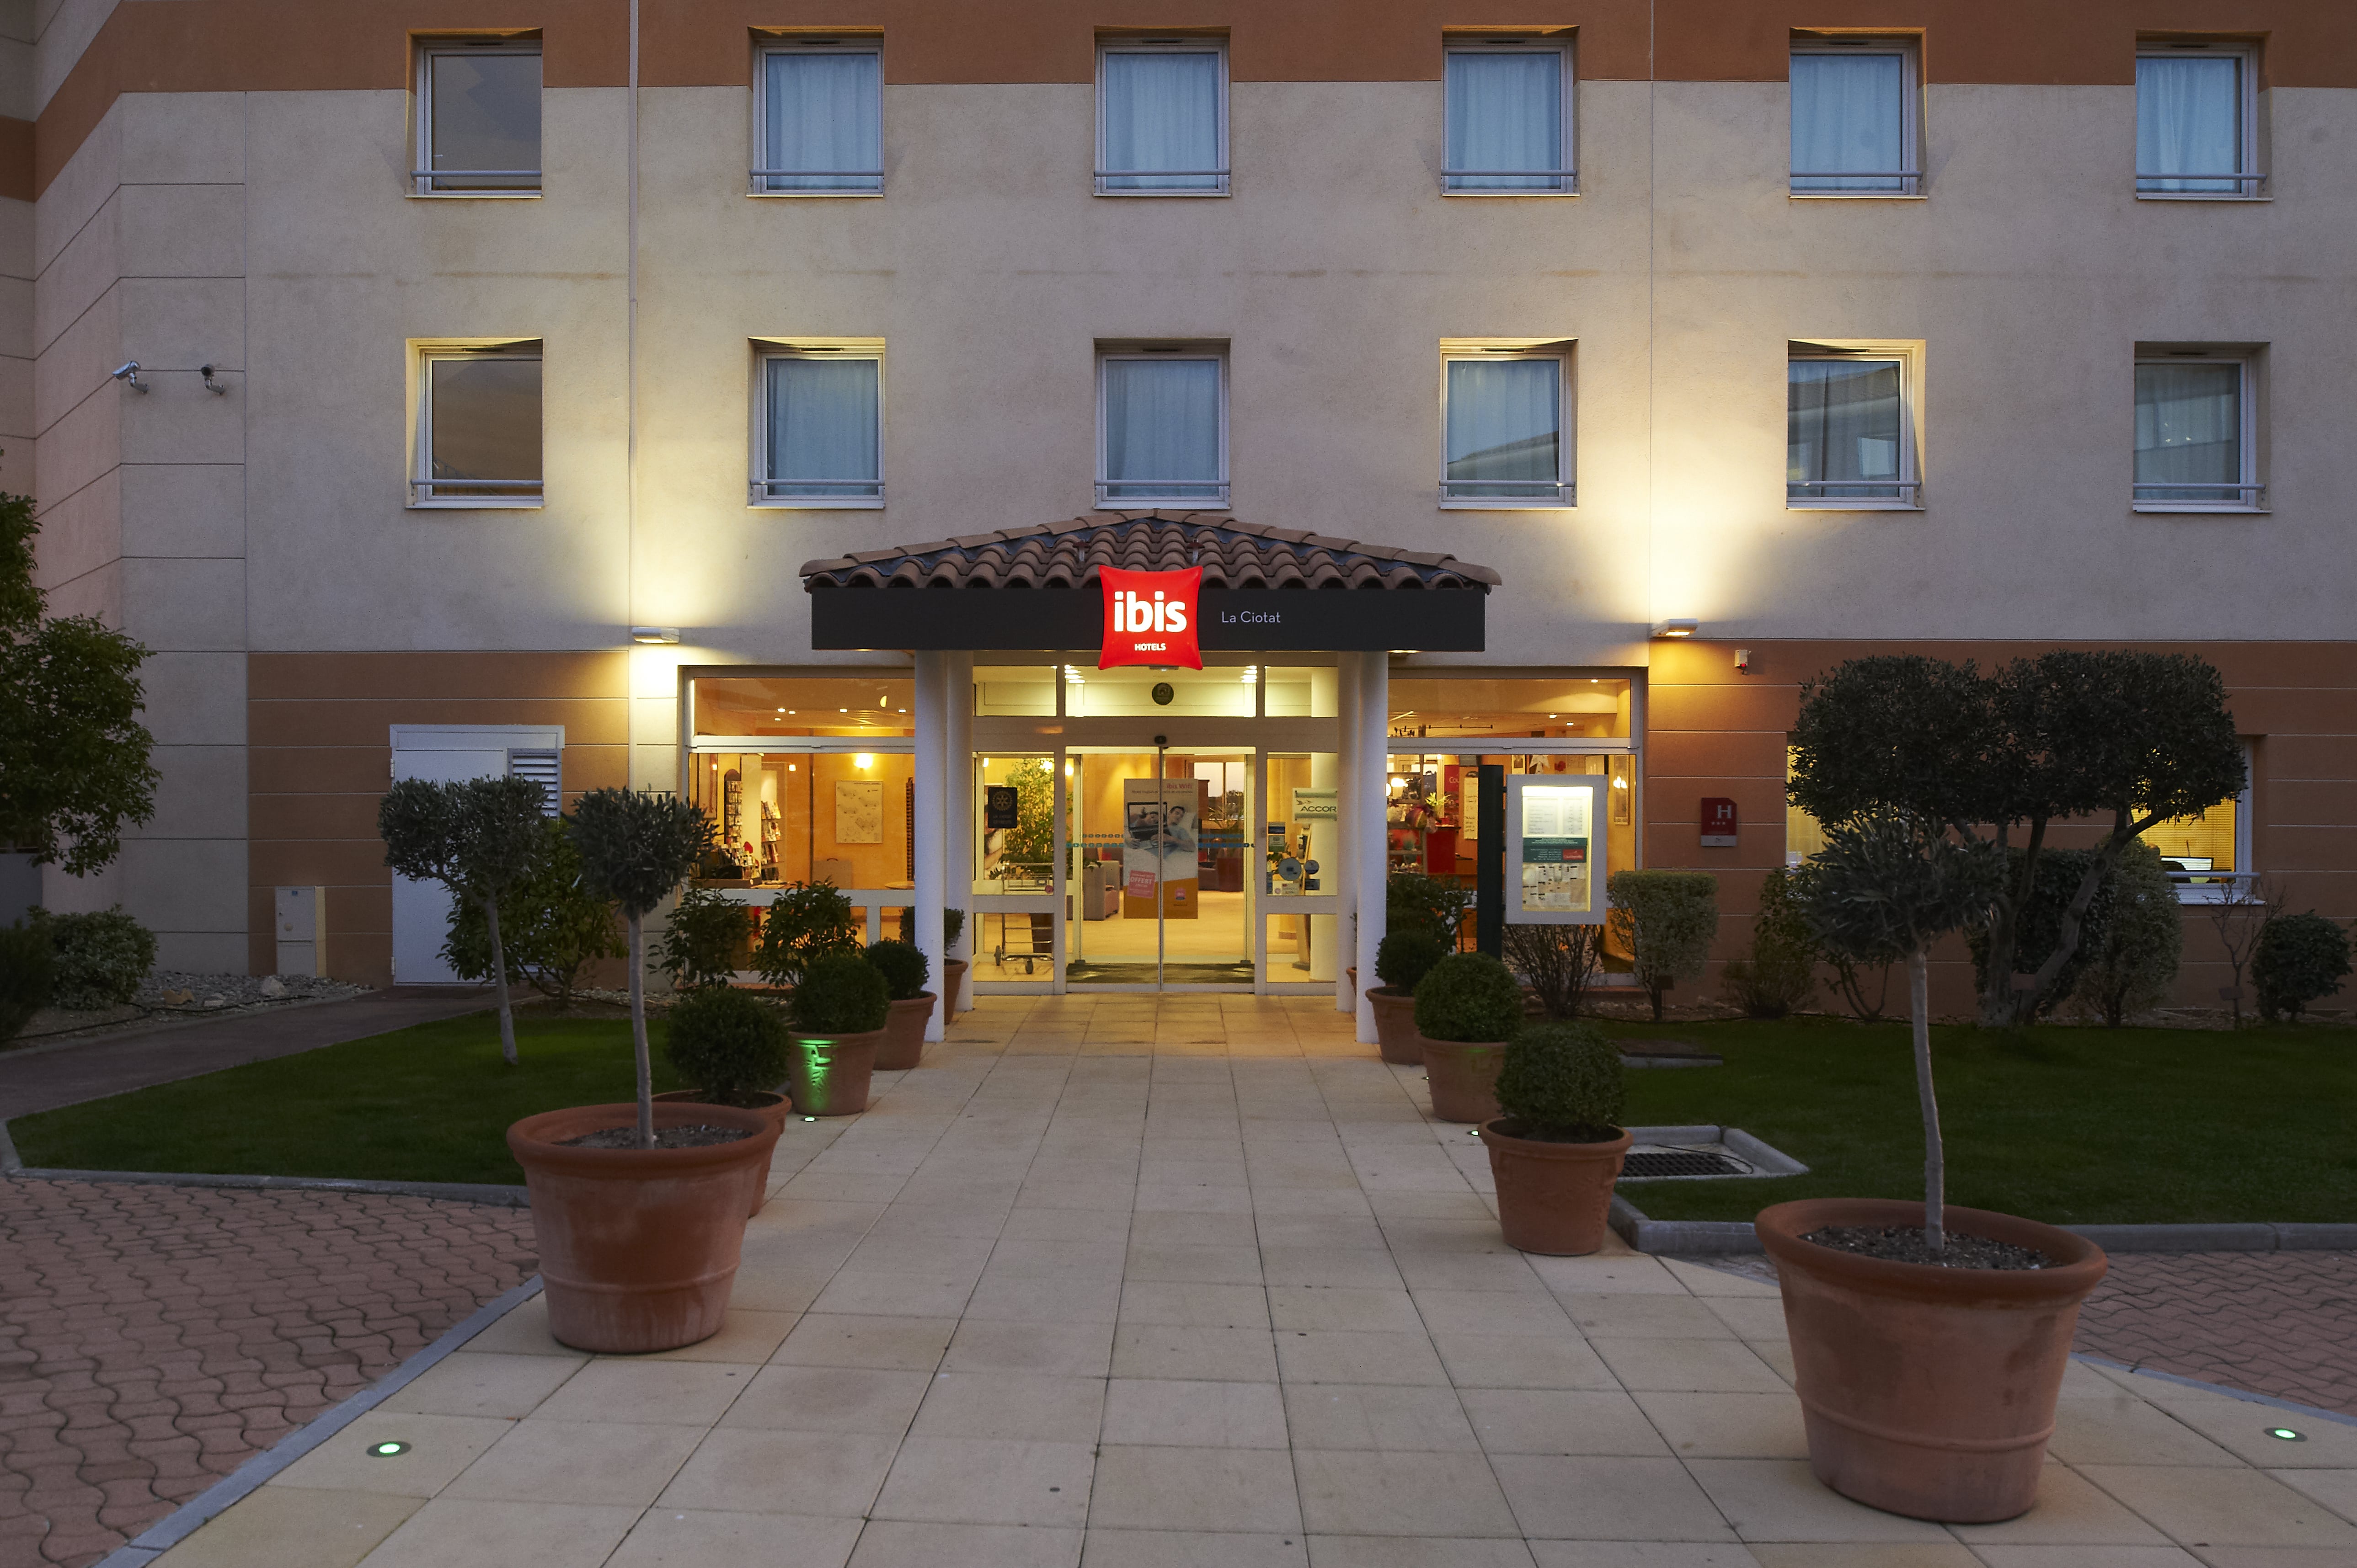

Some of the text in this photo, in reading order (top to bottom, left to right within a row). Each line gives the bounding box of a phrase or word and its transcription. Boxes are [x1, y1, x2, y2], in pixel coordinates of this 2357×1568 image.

[1114, 591, 1187, 632] ibis
[1222, 611, 1281, 623] La Ciotat
[1134, 643, 1166, 651] HOTELS
[1717, 805, 1732, 819] H
[1130, 877, 1152, 885] OFFERT
